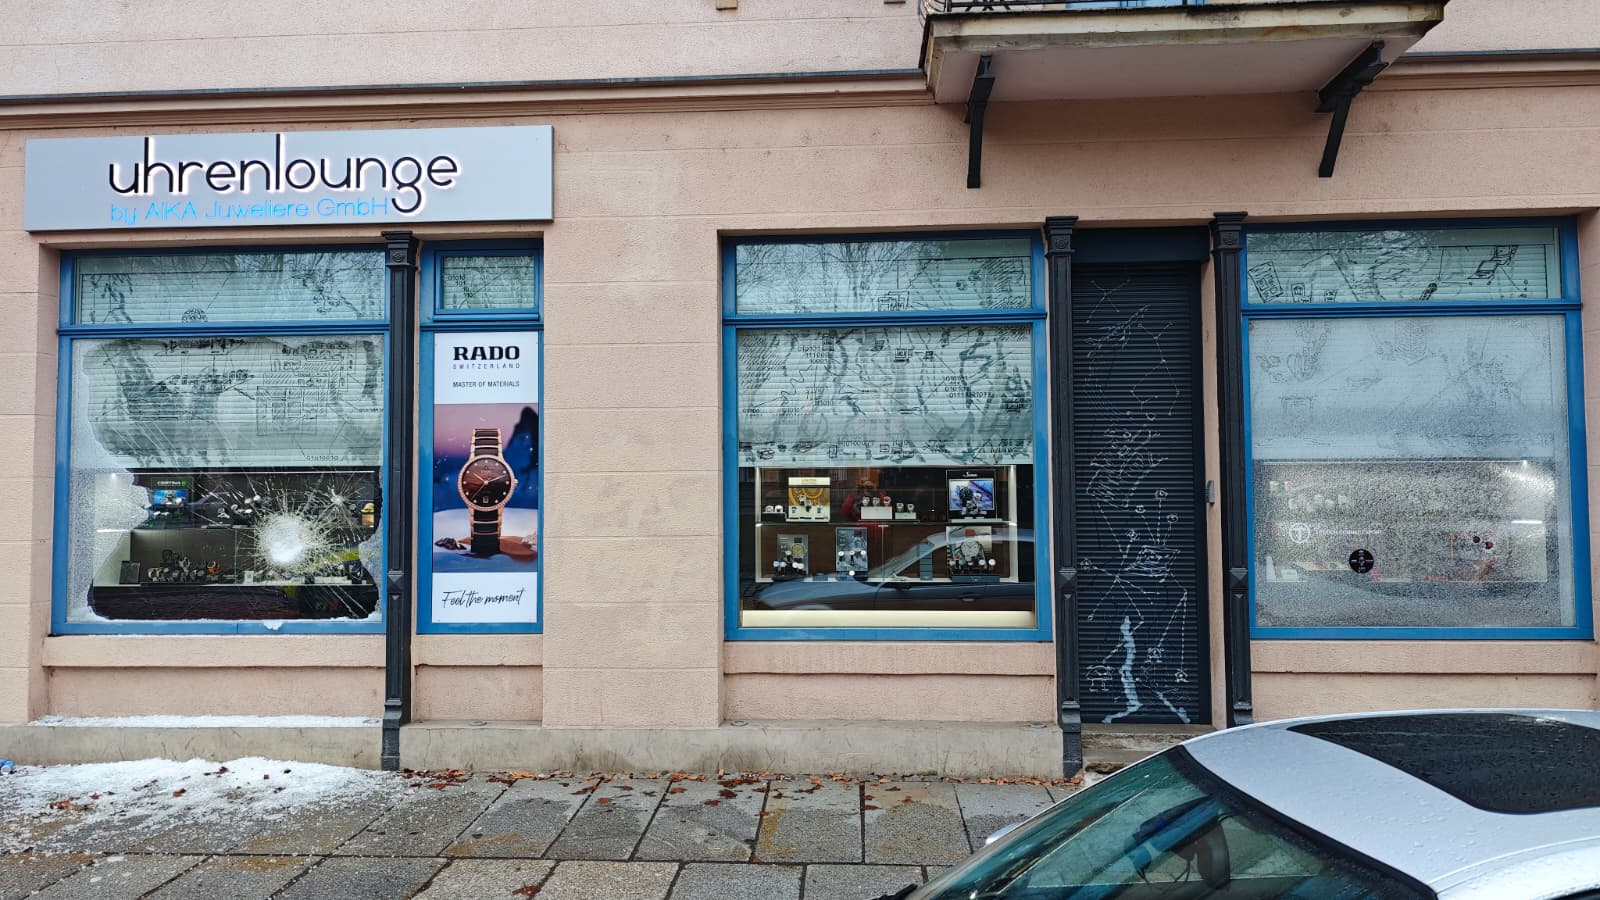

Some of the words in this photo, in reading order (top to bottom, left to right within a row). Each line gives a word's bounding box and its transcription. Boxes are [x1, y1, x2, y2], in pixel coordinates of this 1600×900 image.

[109, 133, 458, 214] uhrenlounge
[111, 203, 137, 225] by
[145, 201, 197, 221] AIKA
[205, 198, 309, 219] Juweliere
[317, 197, 388, 217] GmbH
[453, 345, 520, 361] RADO
[452, 362, 520, 370] SWITZERLAND
[487, 380, 520, 388] MATERIALS
[441, 590, 466, 608] Feel
[465, 589, 483, 608] the
[484, 587, 525, 606] moment
